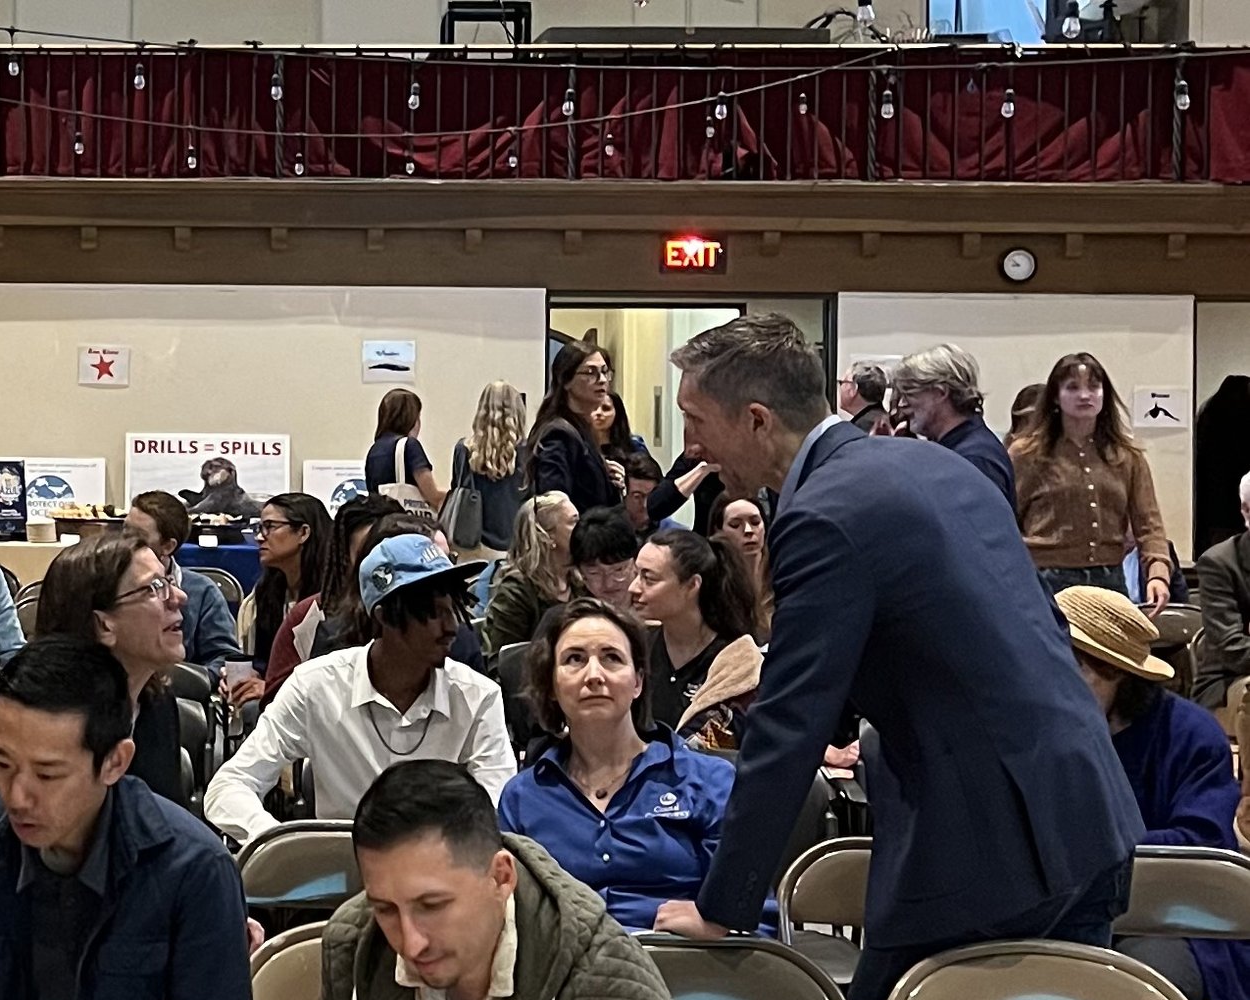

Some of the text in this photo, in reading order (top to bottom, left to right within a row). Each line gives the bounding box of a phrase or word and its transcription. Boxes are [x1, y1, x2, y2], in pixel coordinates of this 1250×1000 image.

[666, 240, 721, 267] EXIT
[134, 440, 198, 454] DRILLS
[220, 441, 281, 455] SPILLS
